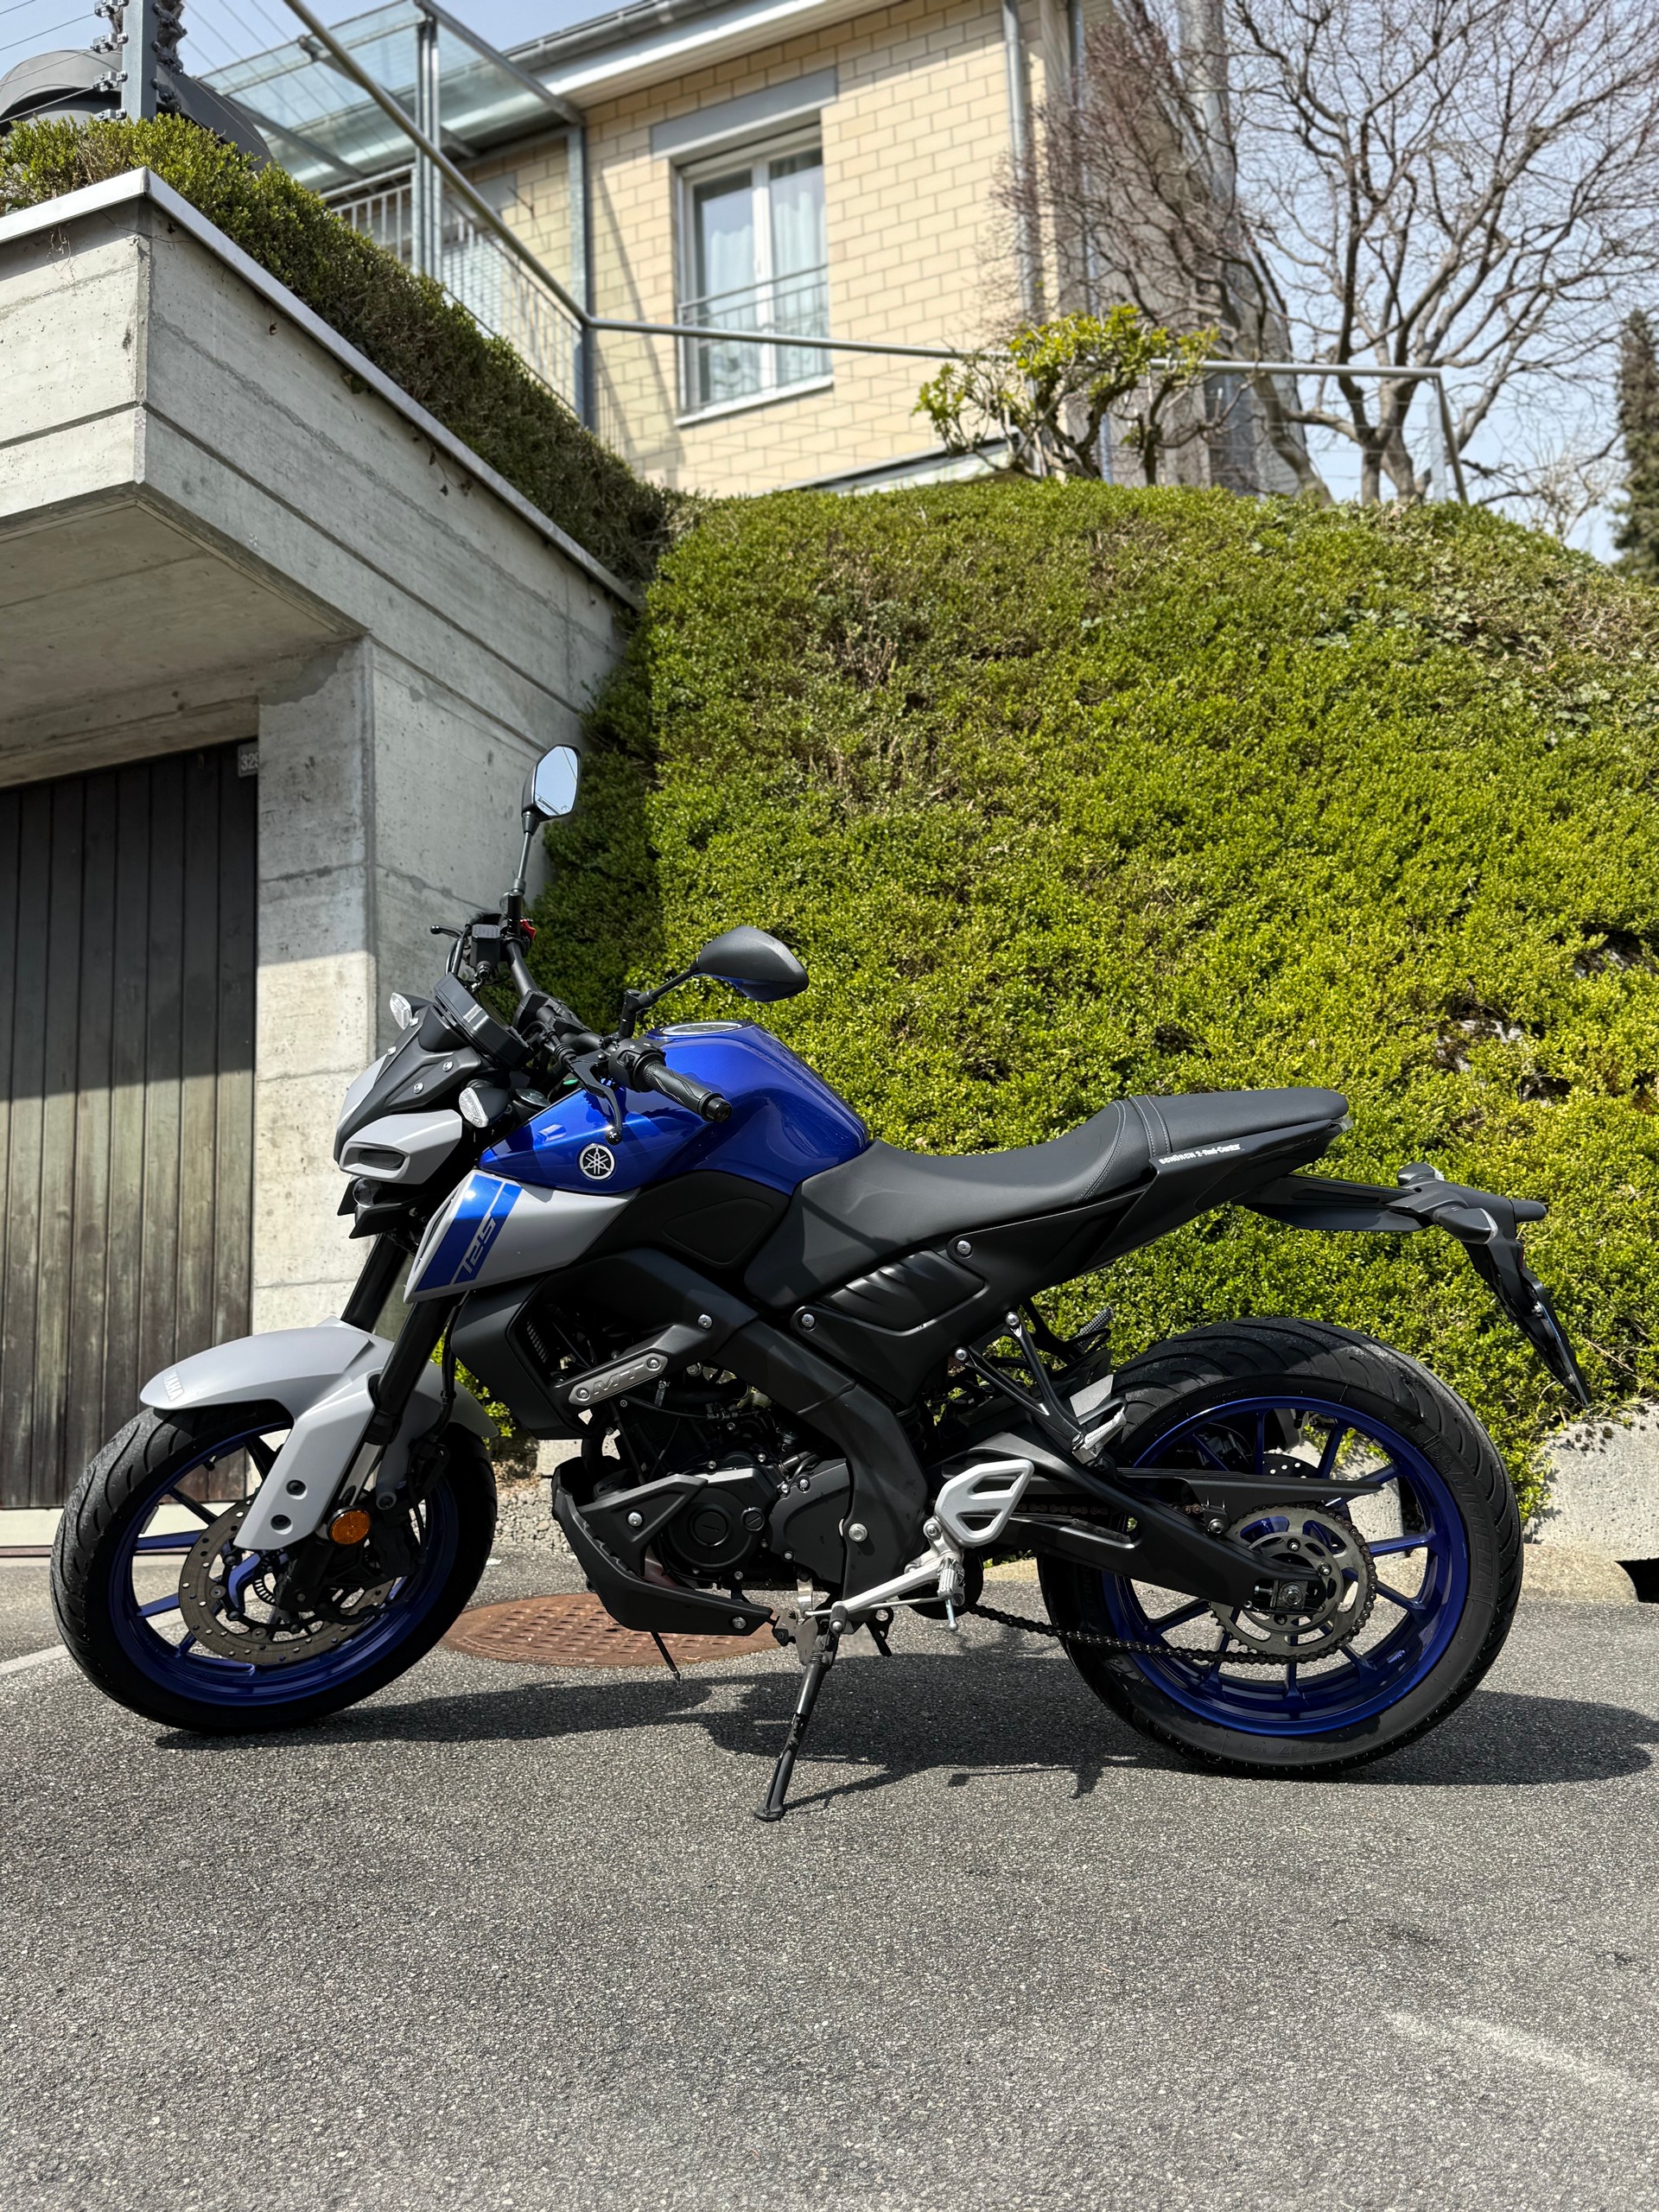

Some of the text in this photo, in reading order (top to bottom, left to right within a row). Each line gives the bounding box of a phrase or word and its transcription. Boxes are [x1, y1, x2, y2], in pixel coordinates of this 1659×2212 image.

[463, 1217, 497, 1274] 125
[594, 1363, 645, 1395] MT
[1449, 1471, 1493, 1594] MICHELIN
